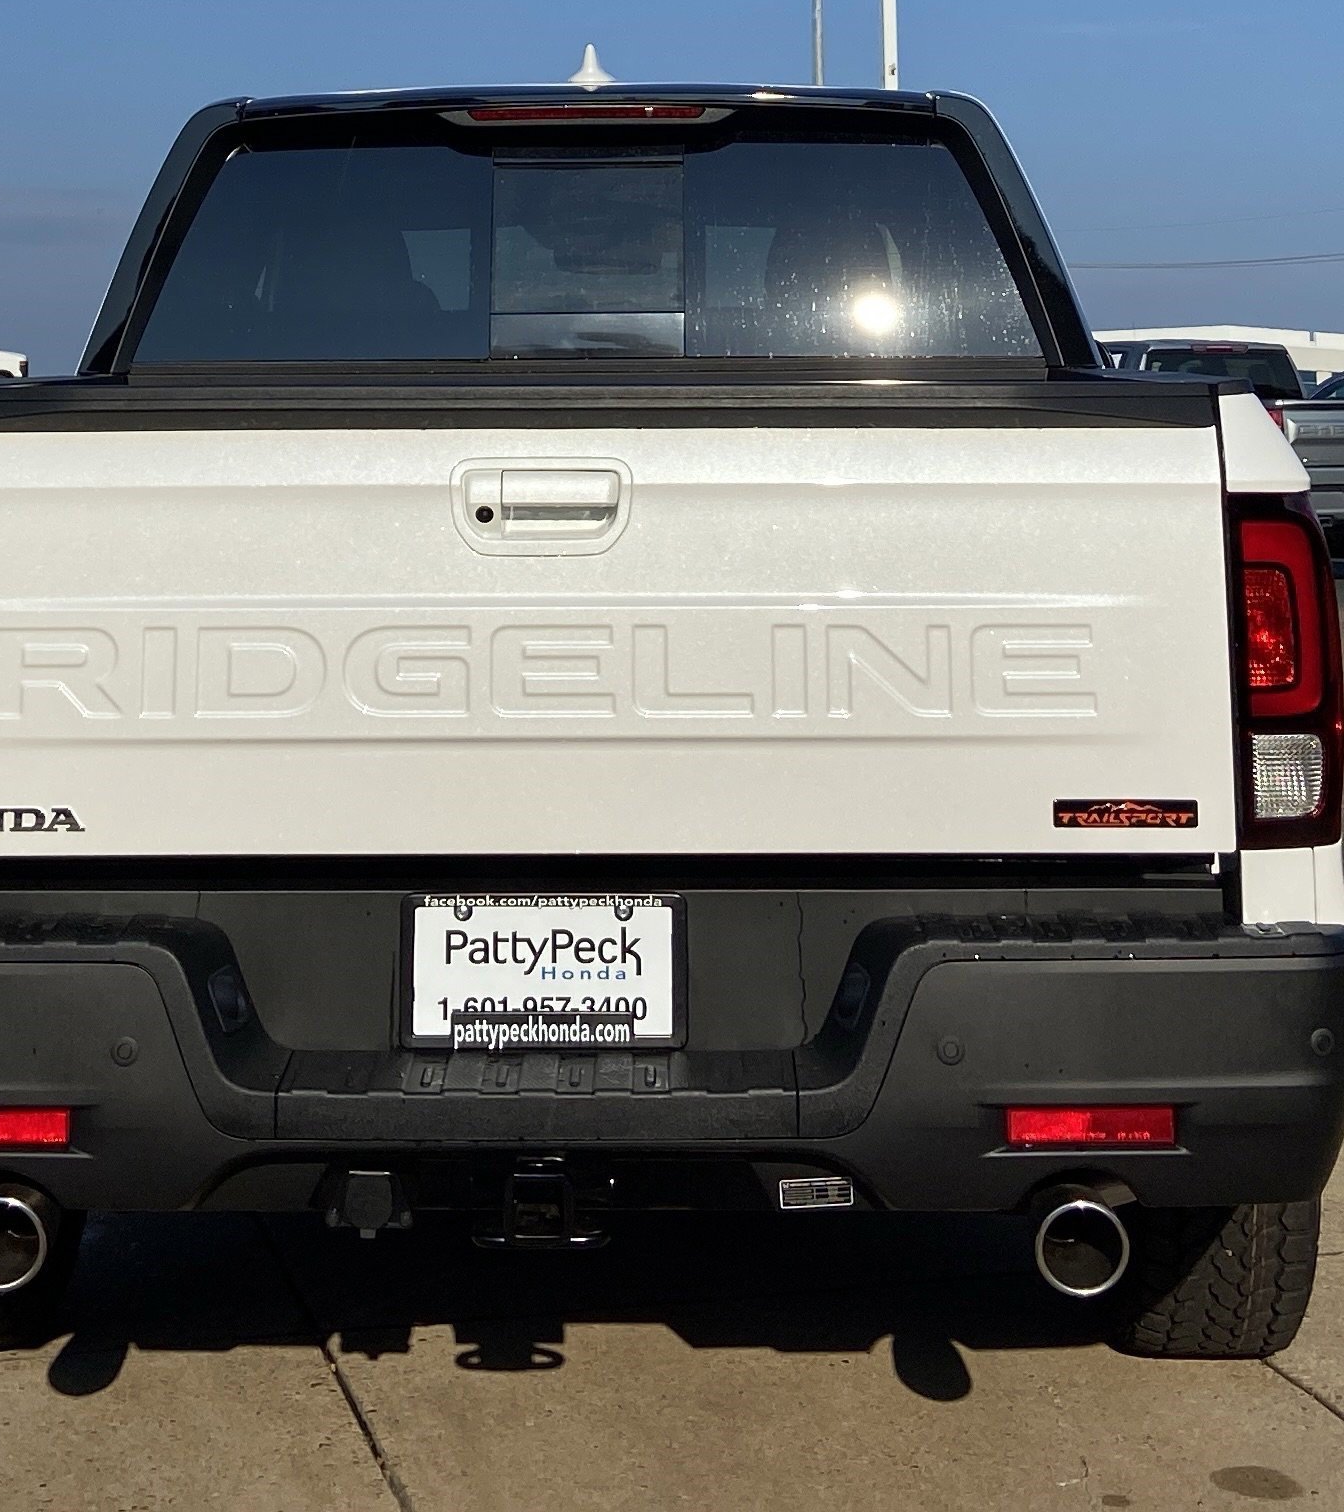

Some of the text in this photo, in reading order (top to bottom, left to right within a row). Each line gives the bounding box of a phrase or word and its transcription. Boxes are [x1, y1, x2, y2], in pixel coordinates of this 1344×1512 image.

[1058, 812, 1194, 827] TRAILSPORT
[424, 895, 662, 908] facebook.com/pattypeckhonda
[445, 927, 642, 976] PattyPeck
[541, 966, 627, 980] Honda
[437, 997, 648, 1021] 1-601-957-3400
[453, 1016, 630, 1050] pattypeckhonda.com
